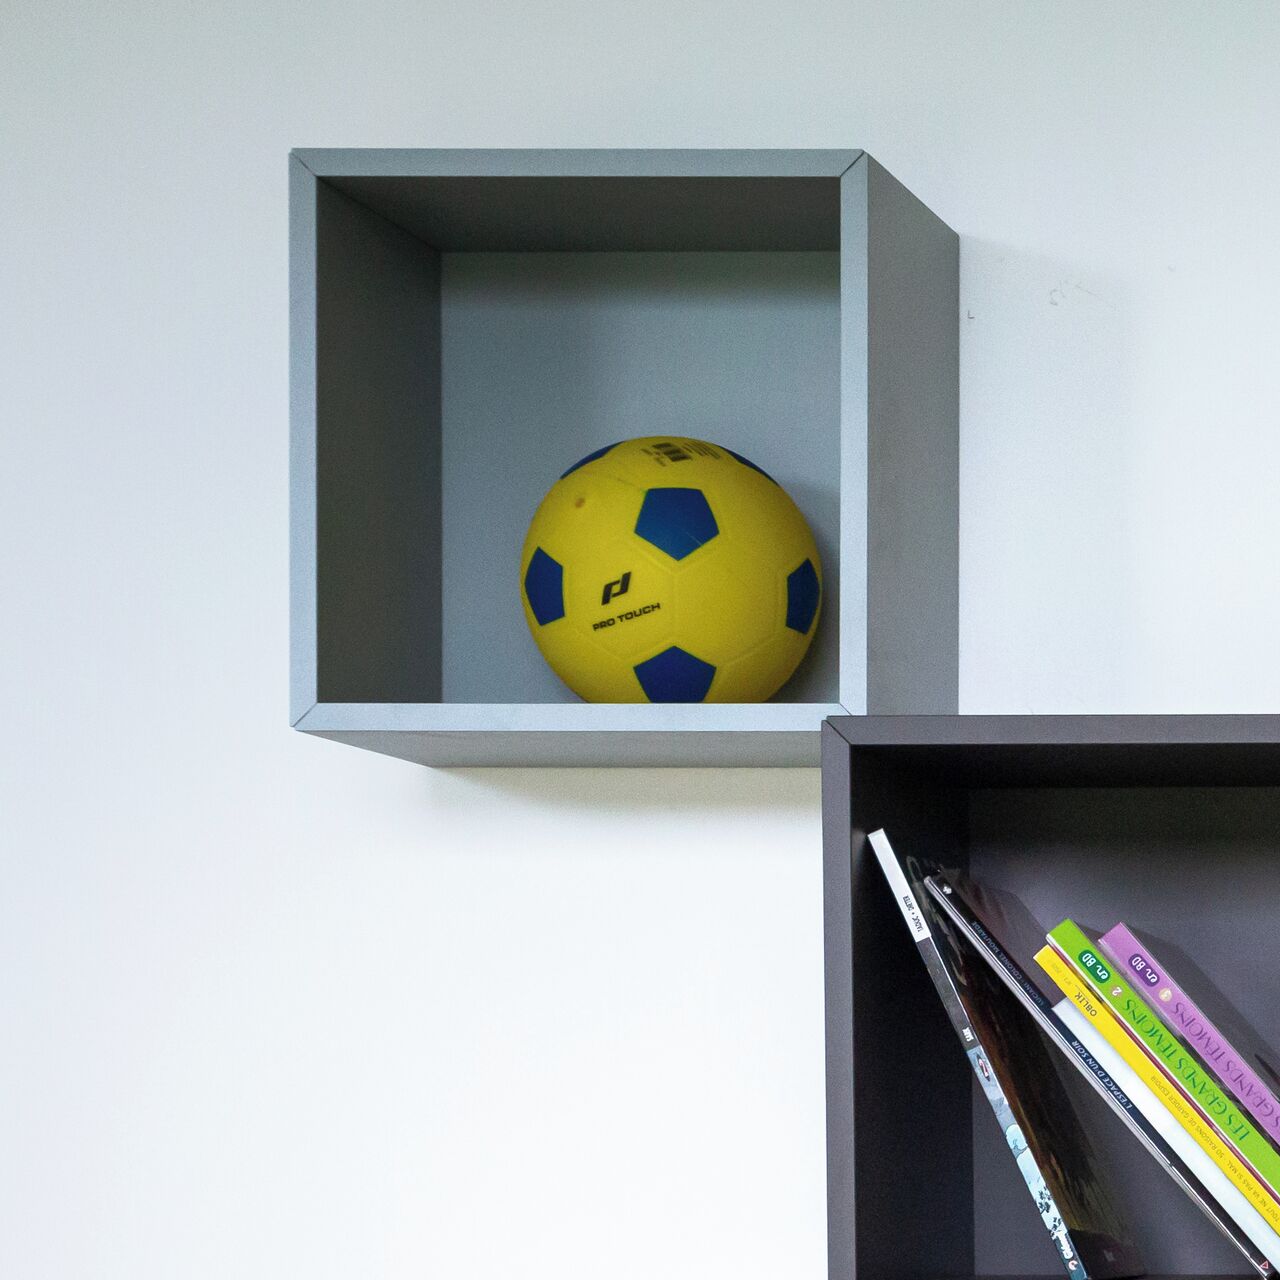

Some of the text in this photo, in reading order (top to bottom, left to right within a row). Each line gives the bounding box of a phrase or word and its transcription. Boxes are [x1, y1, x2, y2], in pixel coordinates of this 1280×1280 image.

[593, 603, 661, 631] PRO TOUCH
[1075, 992, 1097, 1017] OBLIK
[1072, 1040, 1133, 1109] L'ESPACE D'UN SOIR
[1176, 1058, 1250, 1141] LES GRANDS
[1223, 1061, 1274, 1118] GRANDS
